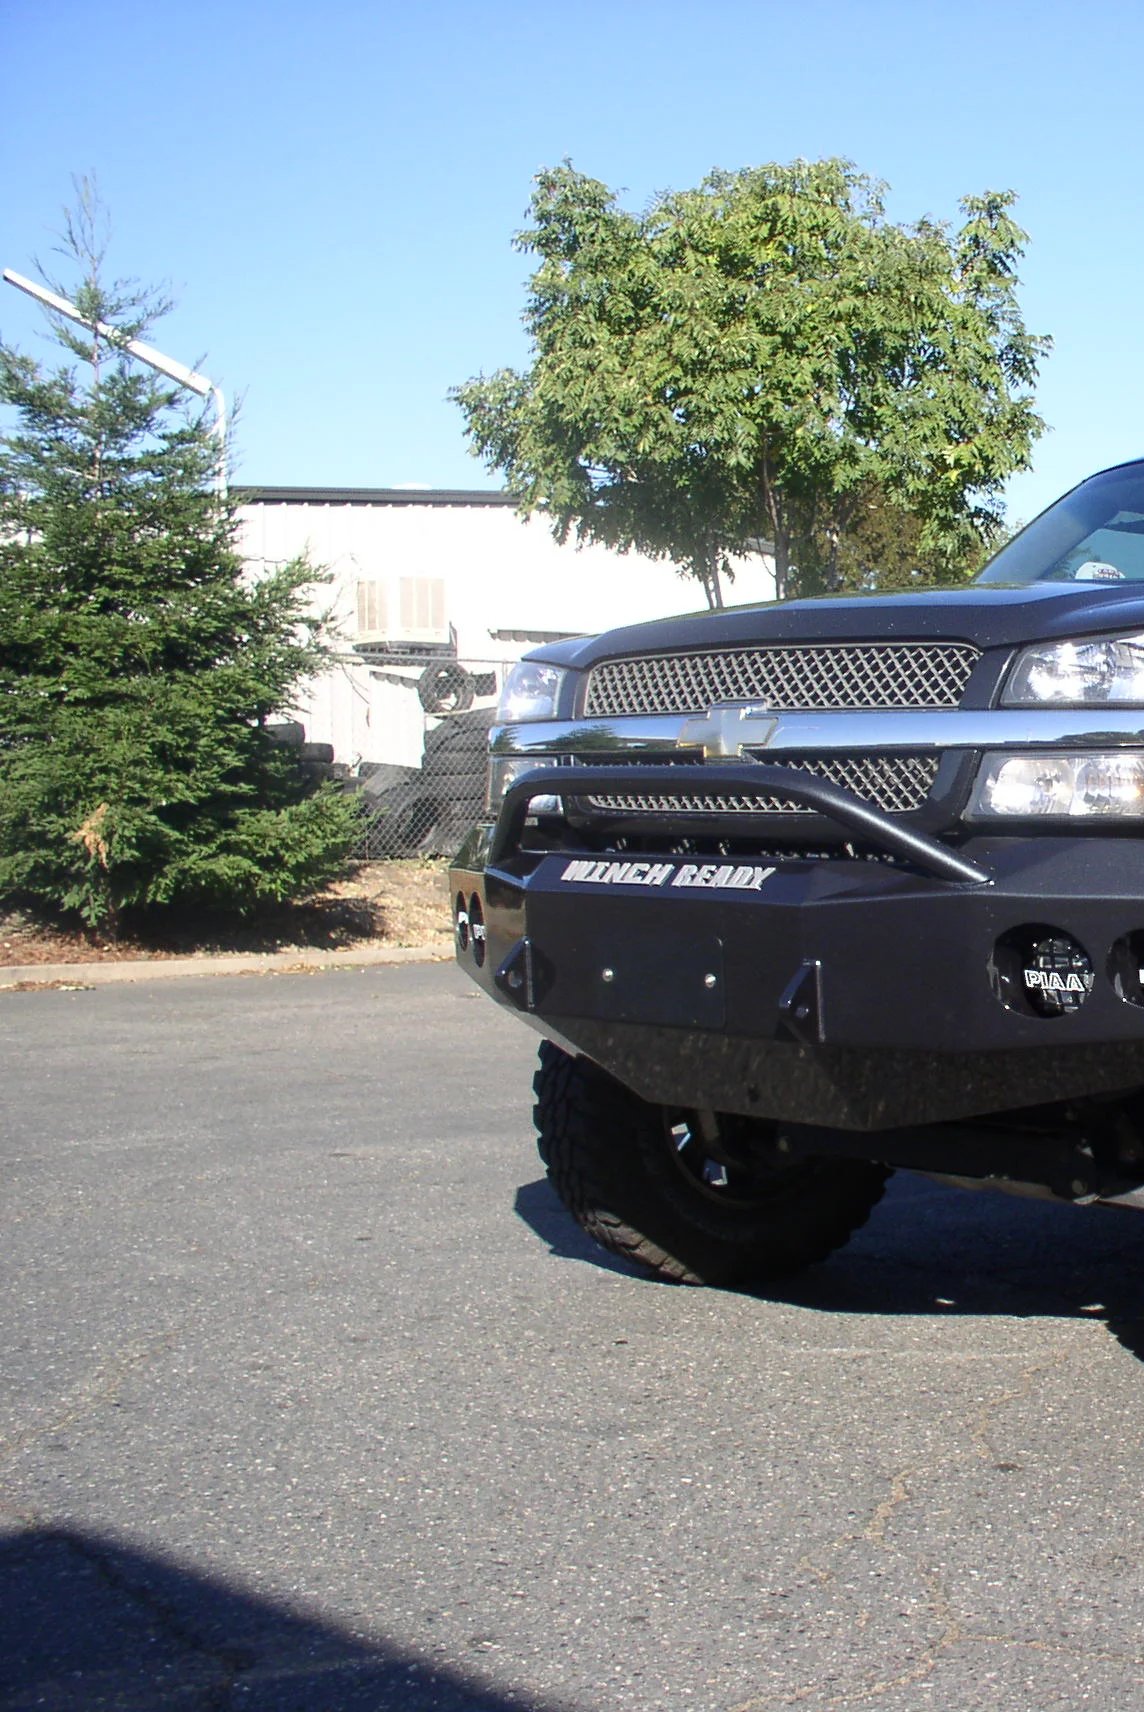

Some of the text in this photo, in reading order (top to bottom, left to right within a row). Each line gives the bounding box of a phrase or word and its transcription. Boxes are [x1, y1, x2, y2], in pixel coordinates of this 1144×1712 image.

[560, 859, 777, 891] WINCH READY
[1023, 968, 1086, 993] PIAA
